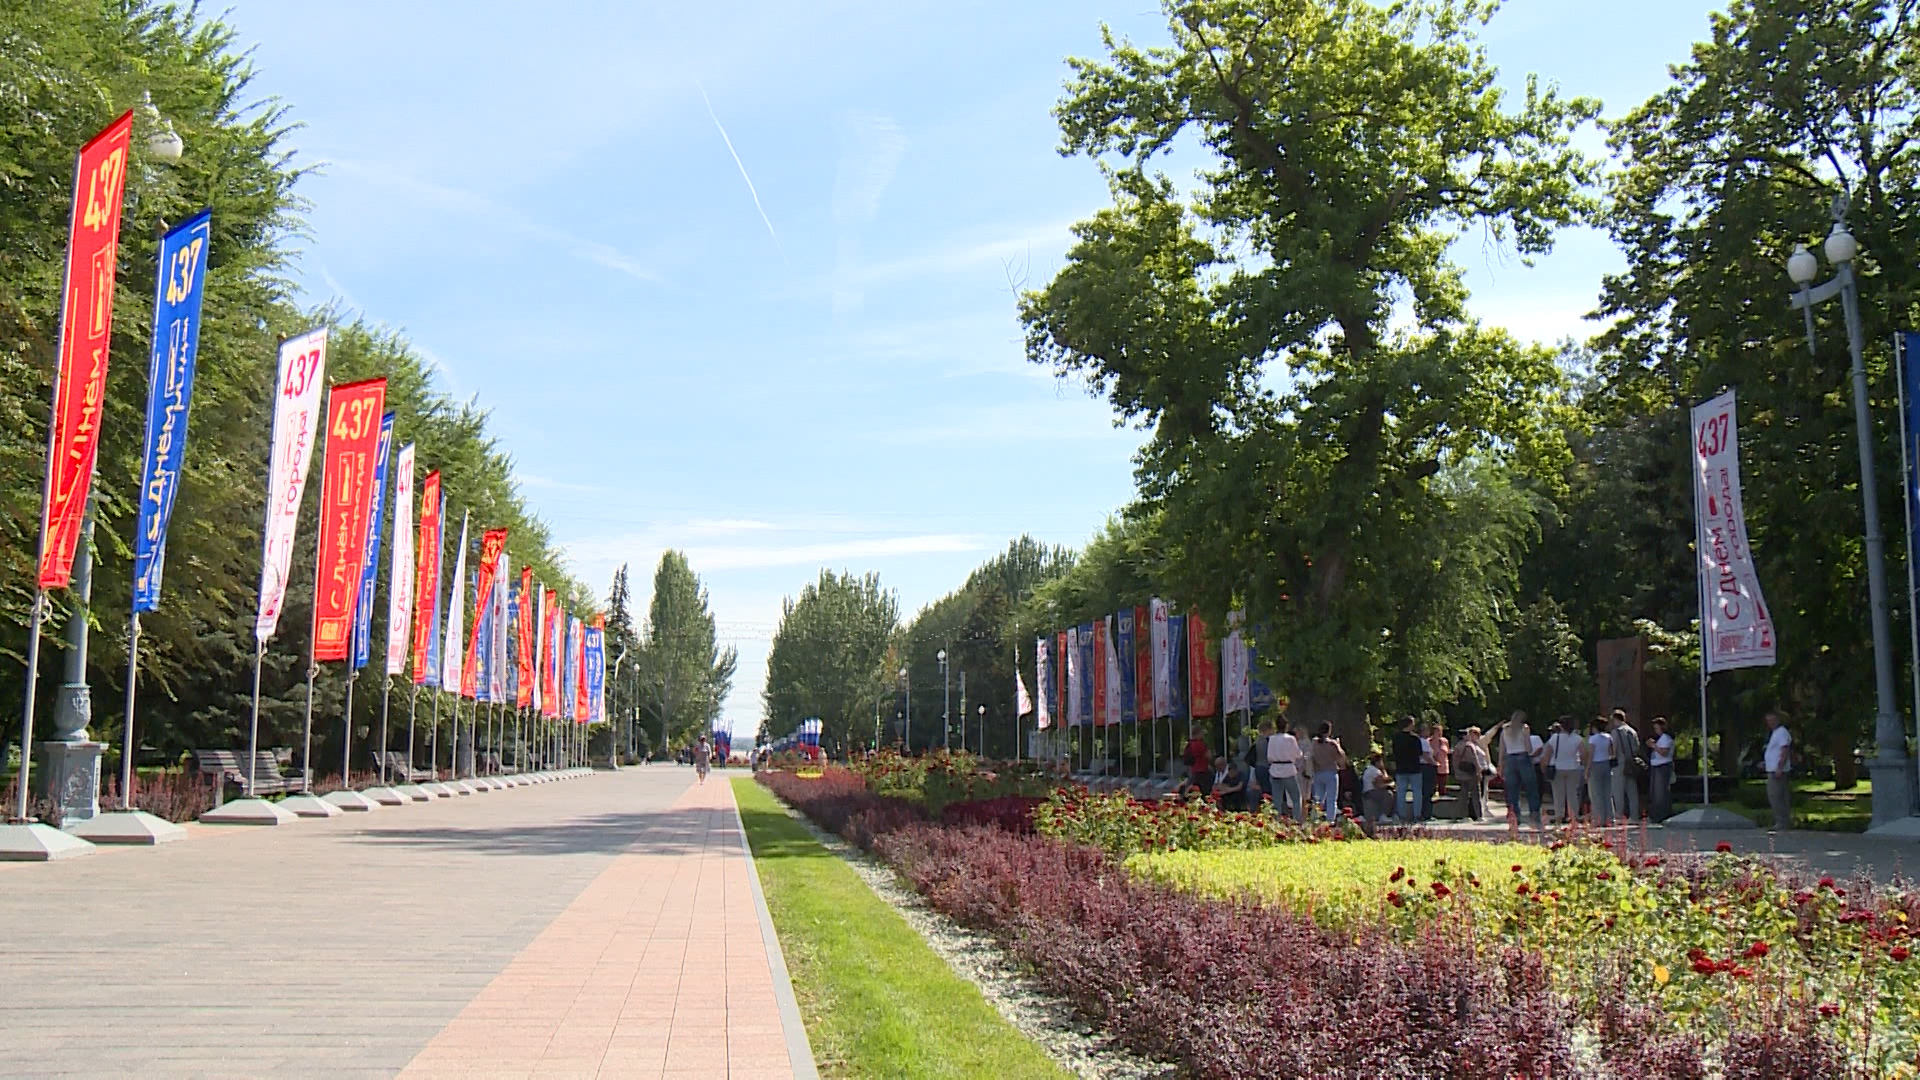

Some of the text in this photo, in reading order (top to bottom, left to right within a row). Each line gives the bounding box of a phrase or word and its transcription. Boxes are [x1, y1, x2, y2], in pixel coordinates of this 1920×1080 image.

[84, 146, 122, 232] 437
[167, 237, 202, 307] 437
[284, 349, 320, 400] 437
[333, 397, 376, 441] 437
[1698, 413, 1728, 458] 437
[149, 404, 176, 506] Днём
[350, 451, 367, 549] города!
[330, 511, 349, 610] С Днём
[1155, 604, 1167, 622] 43
[1724, 601, 1740, 620] С
